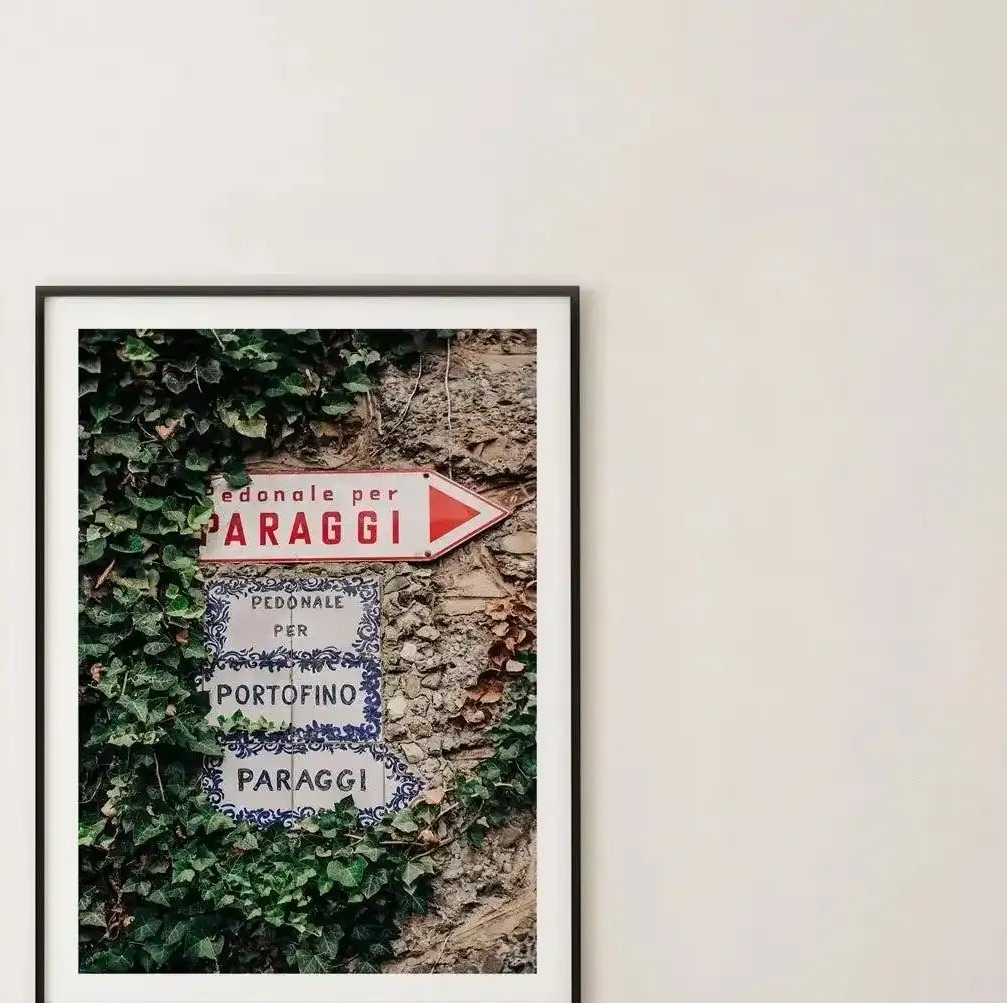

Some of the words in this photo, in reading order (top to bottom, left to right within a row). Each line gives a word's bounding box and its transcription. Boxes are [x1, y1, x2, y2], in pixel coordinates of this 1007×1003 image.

[352, 489, 398, 507] per
[251, 595, 344, 610] PEDONALE
[273, 623, 309, 638] PER
[217, 683, 357, 706] PORTOFINO
[237, 768, 367, 792] PARAGGI
